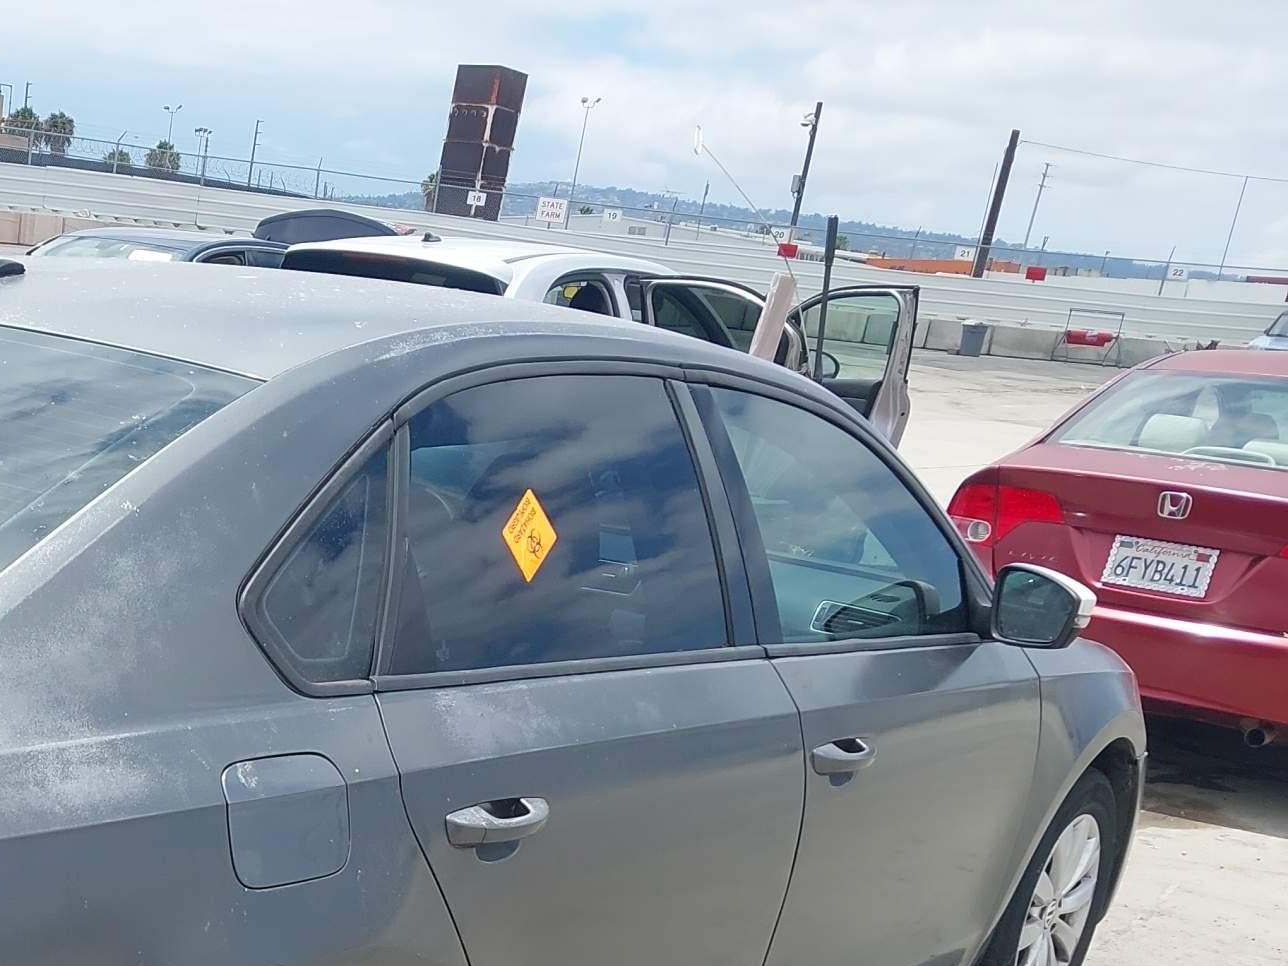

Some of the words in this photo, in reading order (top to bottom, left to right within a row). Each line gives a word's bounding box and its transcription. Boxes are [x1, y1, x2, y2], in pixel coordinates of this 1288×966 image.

[472, 195, 482, 203] 18
[541, 200, 564, 210] STATE
[540, 210, 561, 219] FARM
[608, 212, 617, 220] 19
[774, 230, 785, 239] 20
[960, 249, 970, 258] 21
[1172, 268, 1184, 277] 22
[1134, 541, 1194, 559] California
[1113, 555, 1204, 589] 6FYB411
